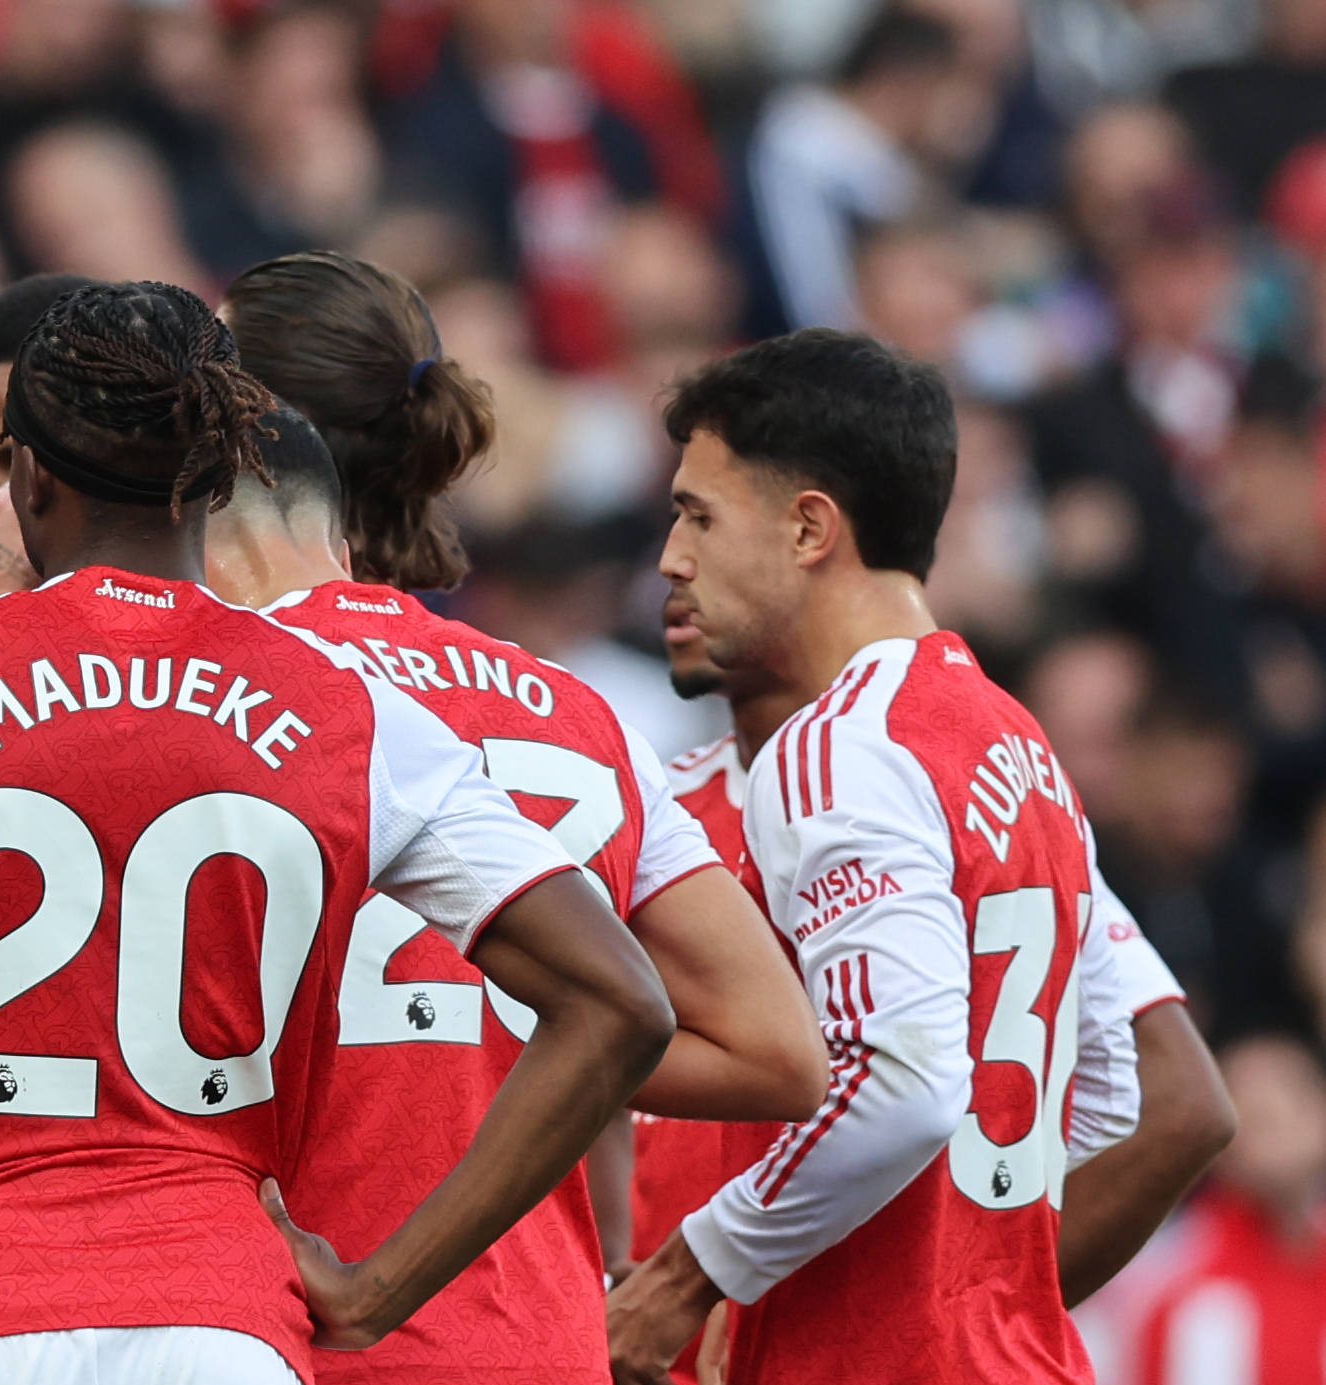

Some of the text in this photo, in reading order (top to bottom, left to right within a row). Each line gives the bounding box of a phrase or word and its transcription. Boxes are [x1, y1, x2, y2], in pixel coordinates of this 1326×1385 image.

[95, 578, 176, 610] Arsenal
[335, 594, 404, 616] Arsenal
[797, 857, 864, 909] VISIT
